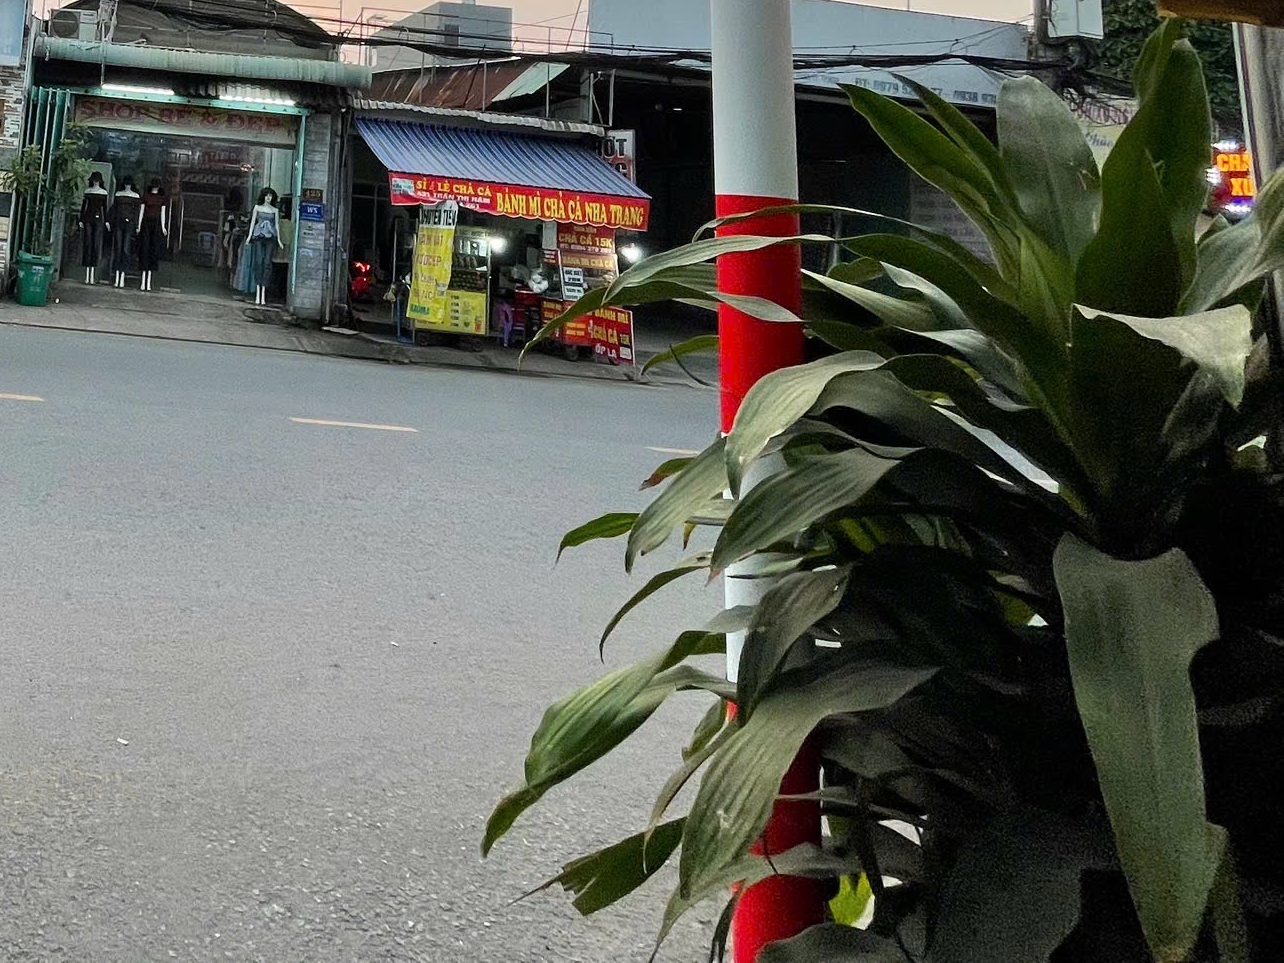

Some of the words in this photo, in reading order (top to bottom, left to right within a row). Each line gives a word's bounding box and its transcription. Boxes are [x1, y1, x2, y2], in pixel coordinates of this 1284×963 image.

[954, 90, 978, 102] 0938
[477, 186, 492, 197] CÁ
[496, 187, 526, 215] BÁNH
[529, 190, 542, 217] MÌ
[545, 190, 566, 218] CHẢ
[568, 195, 583, 221] CÁ
[585, 201, 607, 223] NHA
[609, 203, 644, 227] TRANG
[595, 237, 613, 248] 15K
